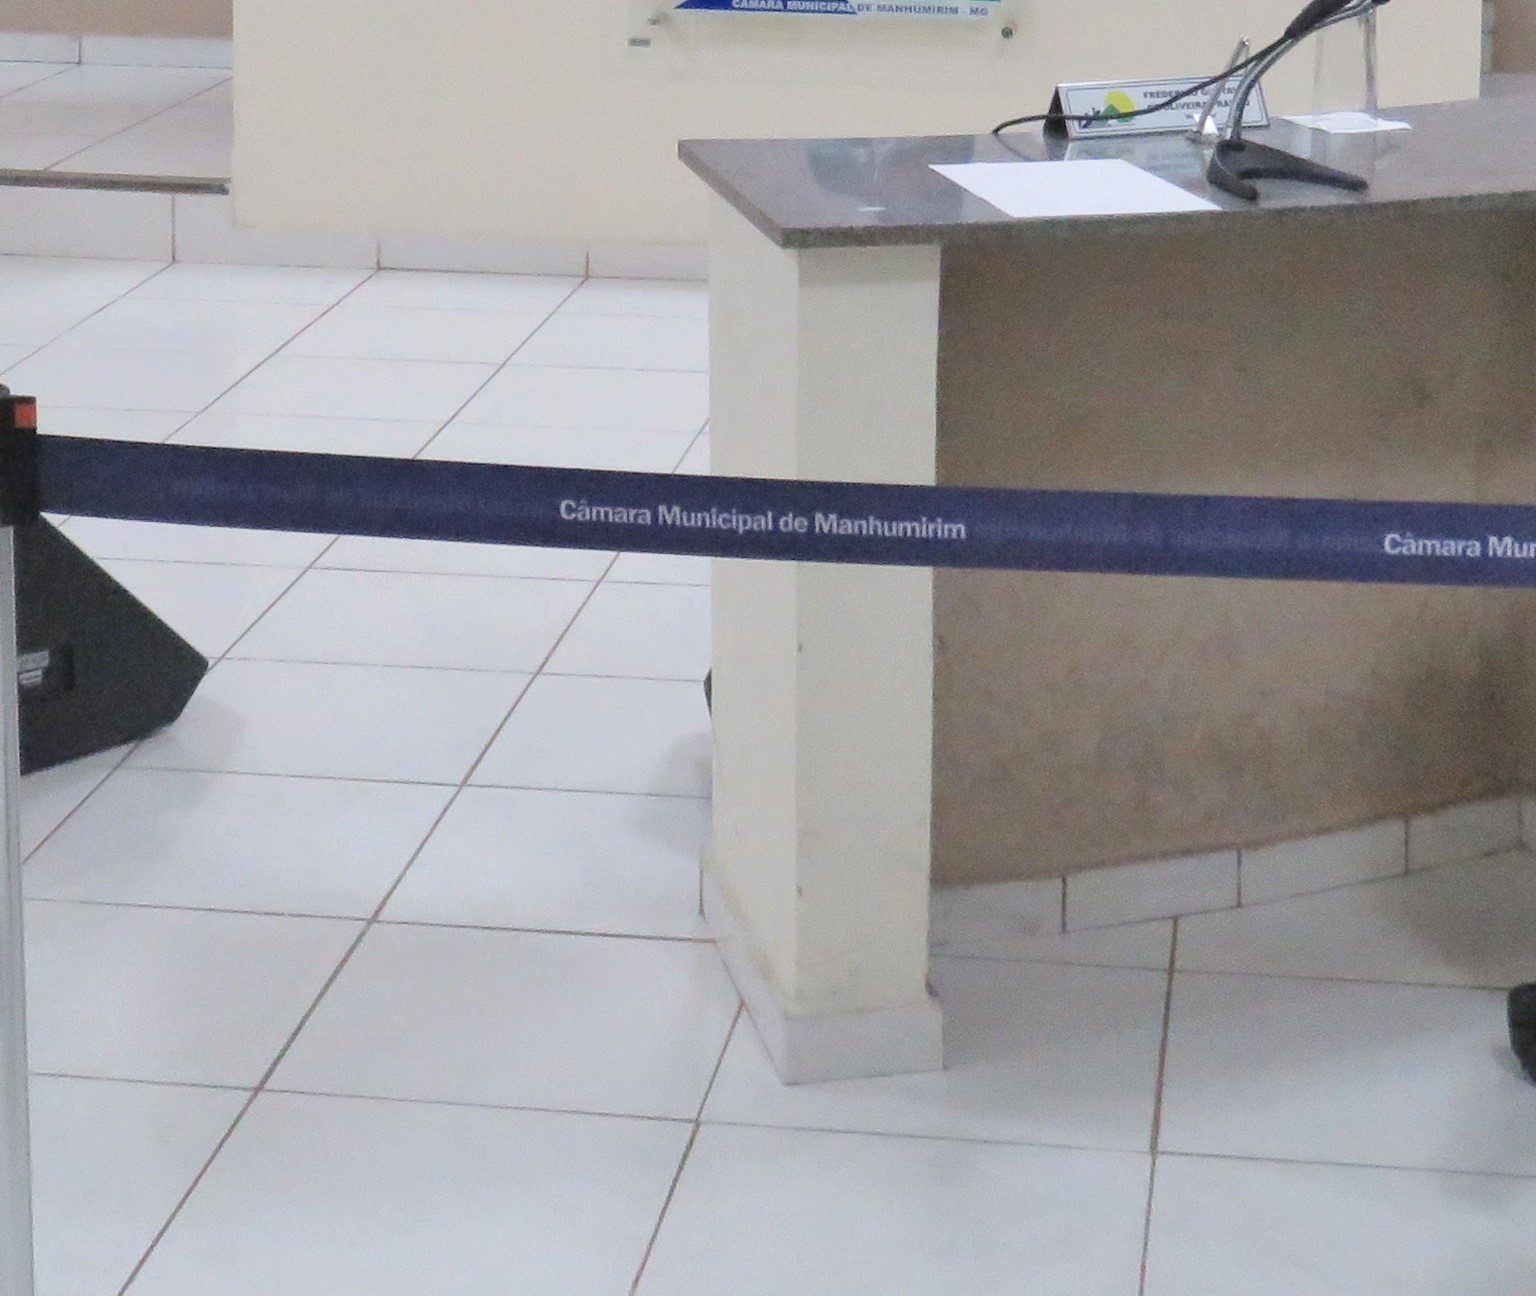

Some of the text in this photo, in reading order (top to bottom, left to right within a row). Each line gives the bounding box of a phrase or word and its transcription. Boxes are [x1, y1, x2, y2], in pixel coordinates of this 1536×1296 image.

[857, 4, 872, 13] DE
[876, 4, 959, 15] MANHUMIRIM
[559, 498, 966, 539] Câmara Municipal de Manhumirim
[1383, 531, 1481, 558] Câmara
